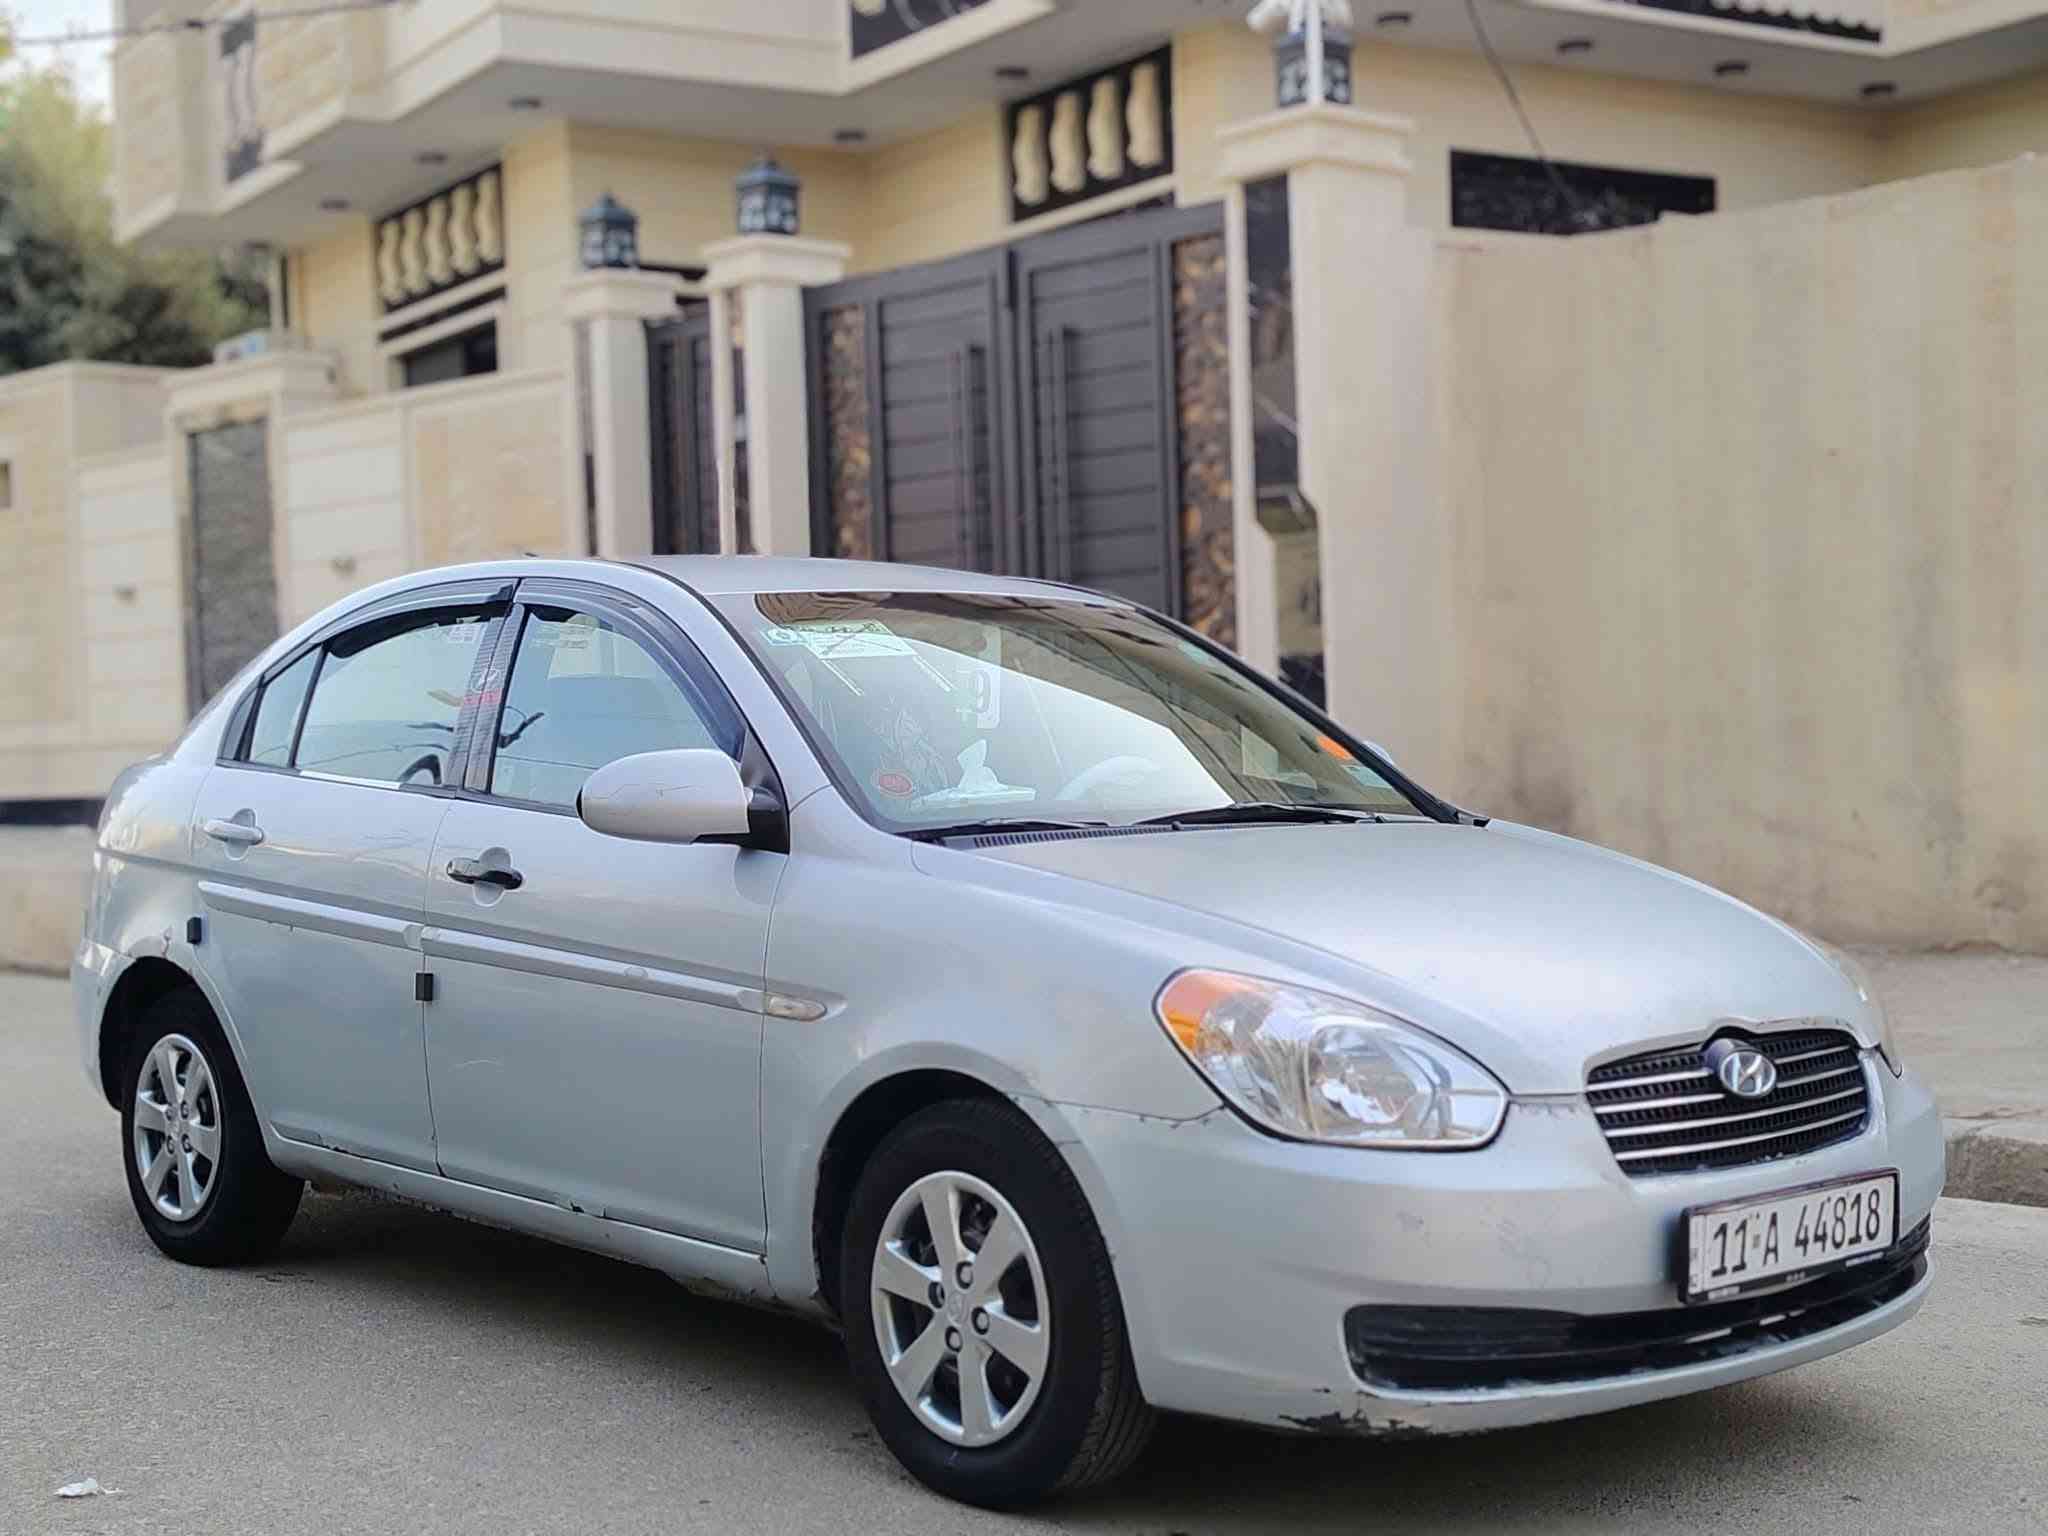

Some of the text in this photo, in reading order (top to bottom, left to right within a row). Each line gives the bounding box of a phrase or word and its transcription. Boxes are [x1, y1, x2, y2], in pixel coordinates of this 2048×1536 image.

[1711, 1218, 1748, 1278] 11
[1762, 1211, 1779, 1267] A
[1794, 1188, 1880, 1257] 44818
